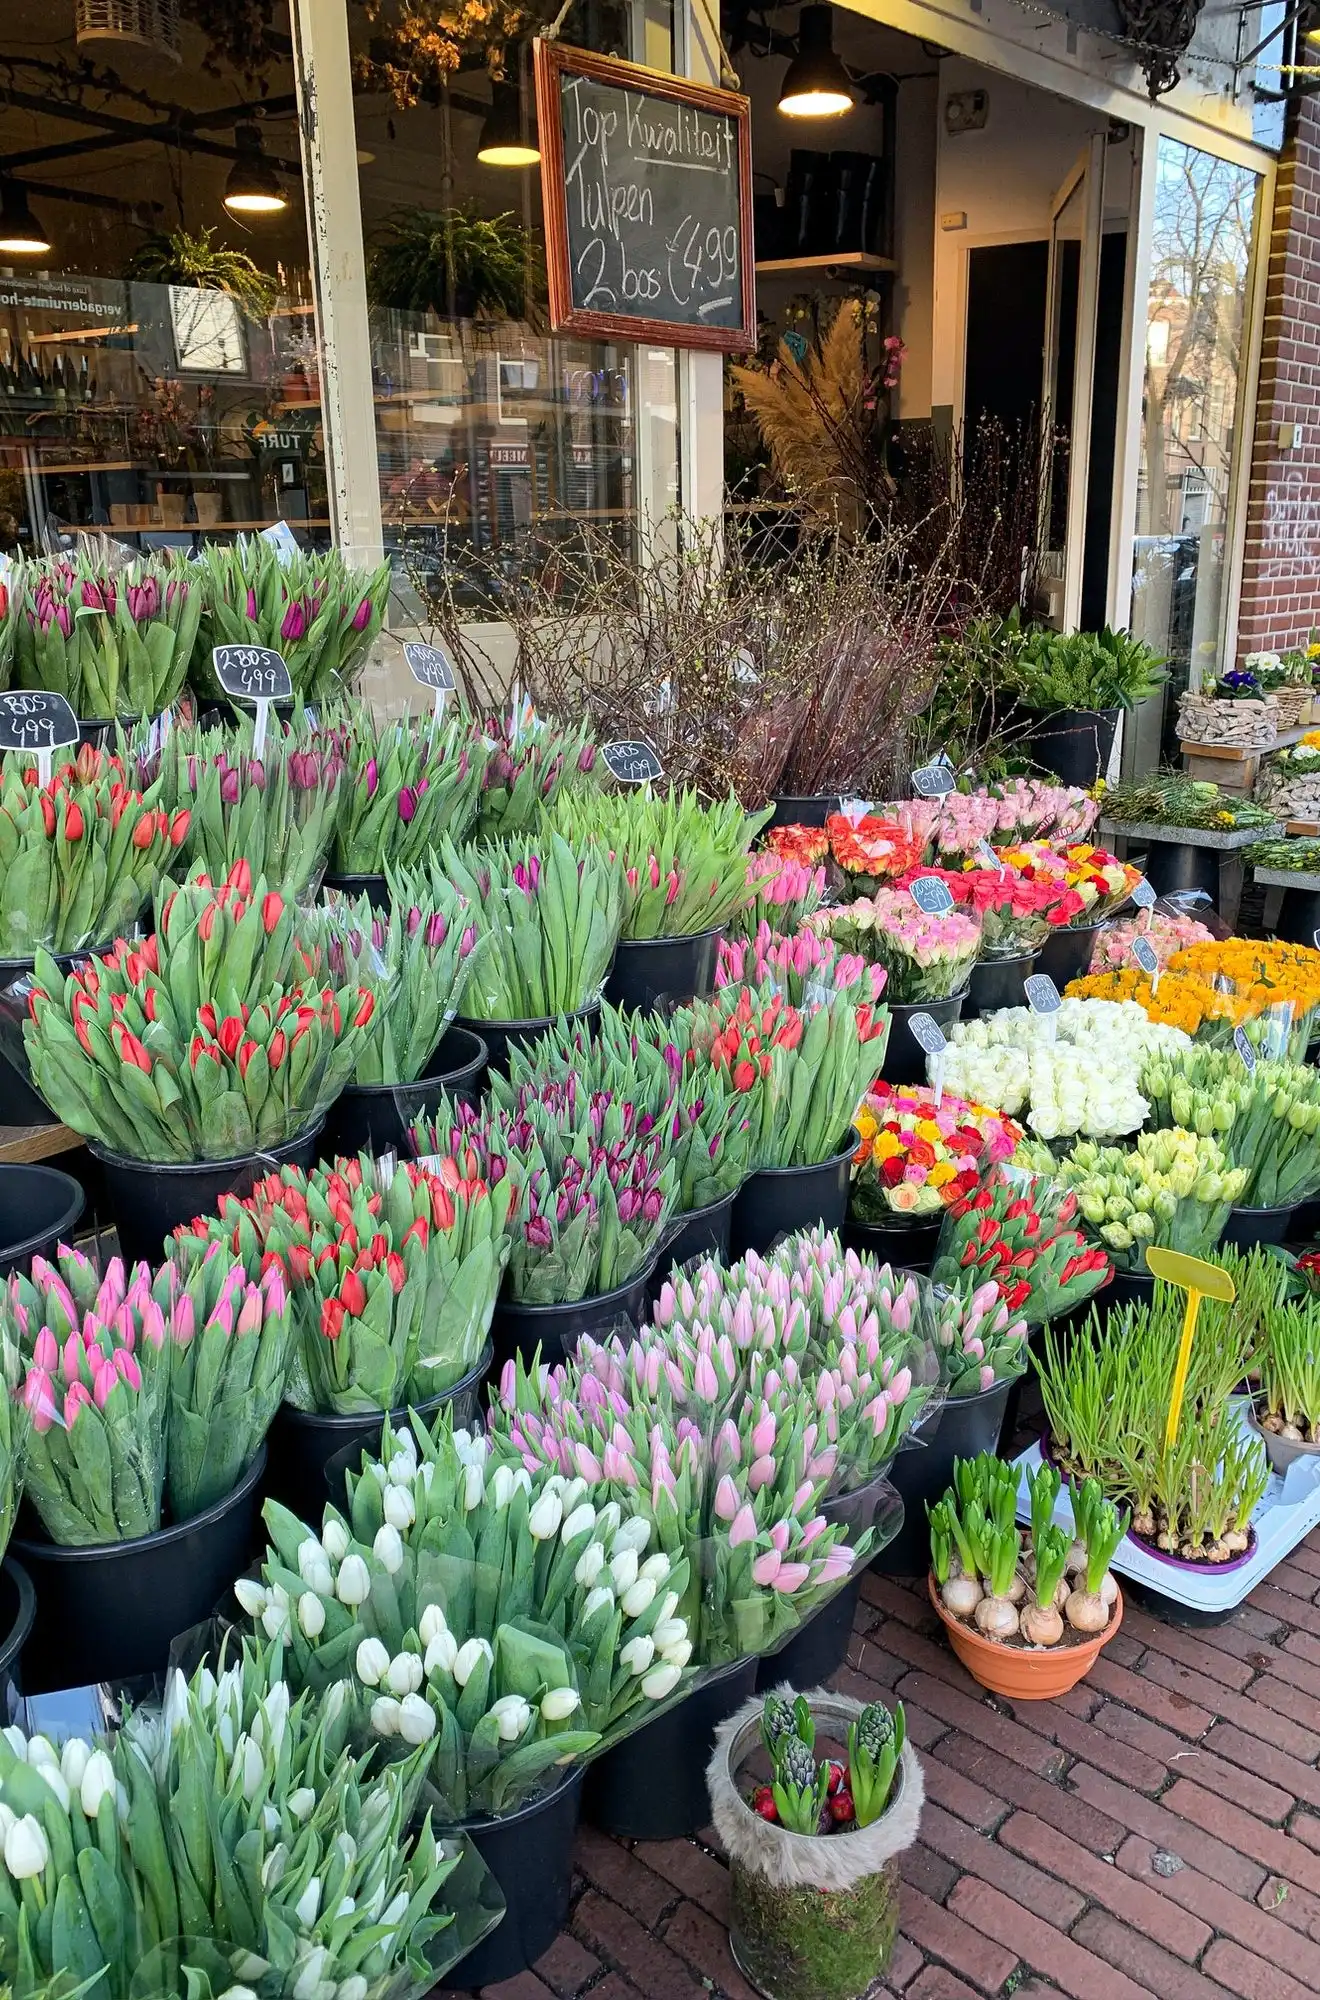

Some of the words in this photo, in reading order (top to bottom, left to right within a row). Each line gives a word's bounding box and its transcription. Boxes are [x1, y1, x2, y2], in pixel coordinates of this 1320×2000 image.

[562, 76, 617, 165] Top
[625, 91, 734, 168] Kwaliteit
[565, 143, 653, 240] Tulpen
[577, 238, 616, 306] 2
[620, 242, 661, 299] bos
[220, 649, 237, 670] 2
[233, 649, 271, 668] BOS
[241, 668, 279, 693] 499
[422, 662, 447, 686] 499
[3, 694, 47, 715] BOS
[11, 717, 56, 748] 499
[623, 759, 651, 779] 499
